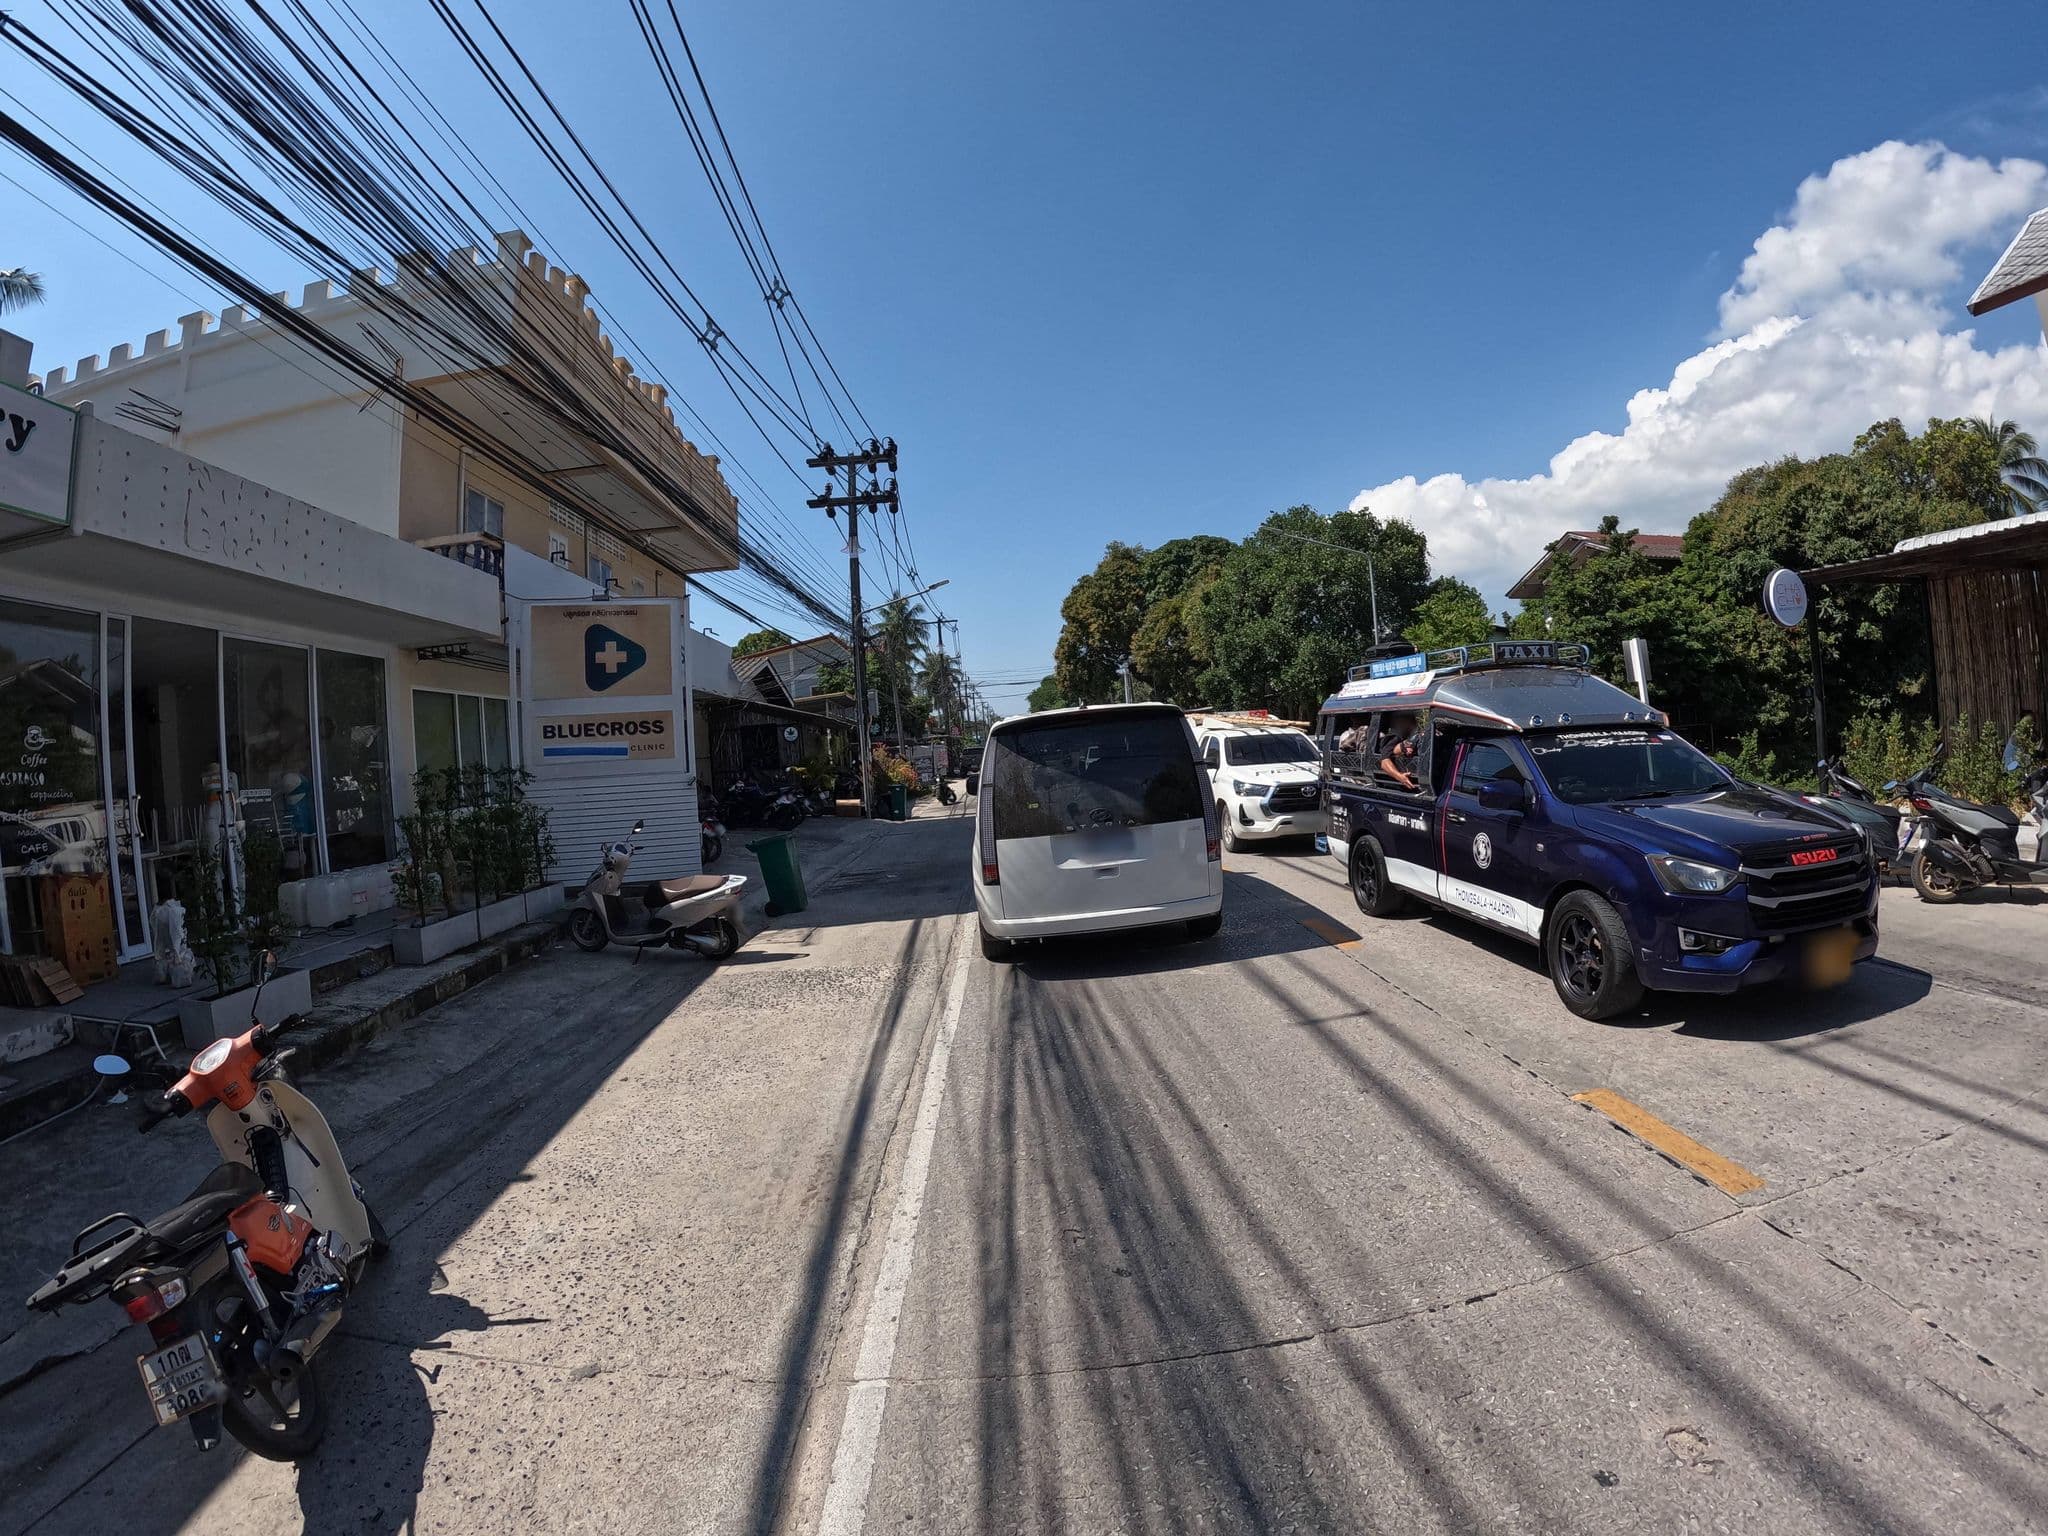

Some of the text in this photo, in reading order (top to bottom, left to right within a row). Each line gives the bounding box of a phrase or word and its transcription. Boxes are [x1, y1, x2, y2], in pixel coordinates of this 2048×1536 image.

[1500, 645, 1551, 659] TAXI
[543, 720, 665, 739] BLUECROSS
[630, 743, 665, 752] CLINIC
[20, 753, 48, 767] Coffee
[30, 788, 74, 801] cappuccino
[1791, 848, 1837, 866] ISUZU
